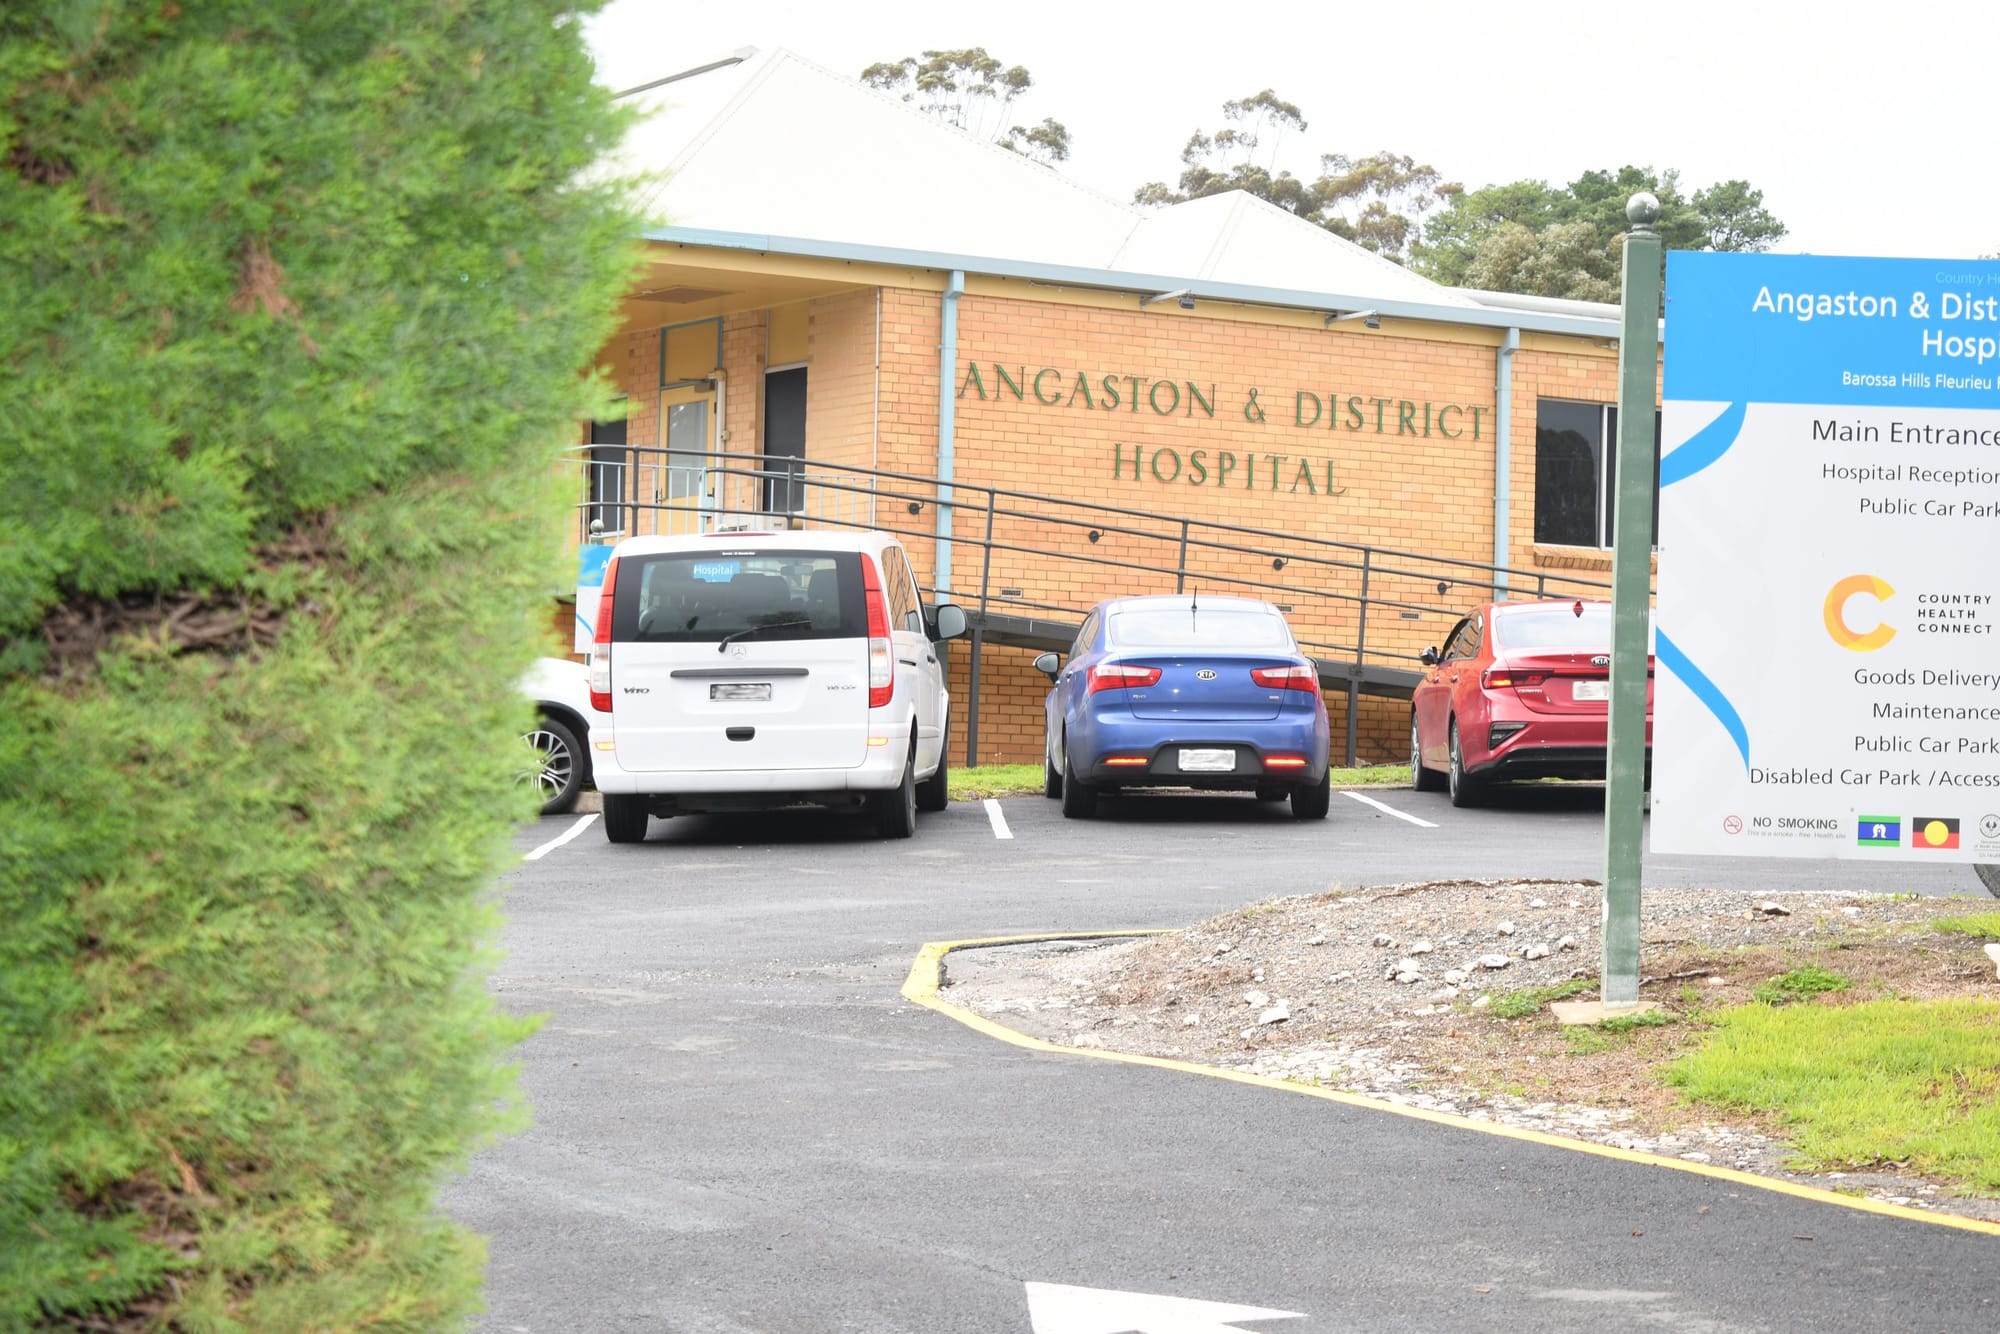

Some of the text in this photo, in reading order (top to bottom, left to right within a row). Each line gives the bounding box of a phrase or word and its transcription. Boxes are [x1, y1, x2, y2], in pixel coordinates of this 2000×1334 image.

[1935, 271, 1984, 287] Country
[1752, 285, 1898, 322] Angaston
[1909, 291, 1930, 319] &
[1842, 371, 1897, 388] Barossa
[1901, 371, 1931, 389] Hills
[1935, 373, 1992, 390] Fleurieu
[957, 360, 1489, 441] ANGASTON & DISTRICT
[1812, 420, 2000, 447] Main Entrance
[1113, 442, 1348, 496] HOSPITAL
[1822, 463, 1901, 484] Hospital
[1859, 497, 1918, 516] Public
[1924, 499, 1956, 516] Car
[693, 563, 734, 577] Hospital
[1918, 594, 1992, 605] COUNTRY
[1917, 608, 1976, 619] HEALTH
[1917, 623, 1993, 634] CONNECT
[1854, 668, 2000, 691] Goods Delivery
[1872, 702, 2000, 721] Maintenance
[1854, 736, 2000, 754] Public Car Park
[1750, 767, 1833, 786] Disabled
[1840, 768, 1873, 786] Car
[1879, 768, 1921, 786] Park
[1752, 816, 1839, 830] NO SMOKING
